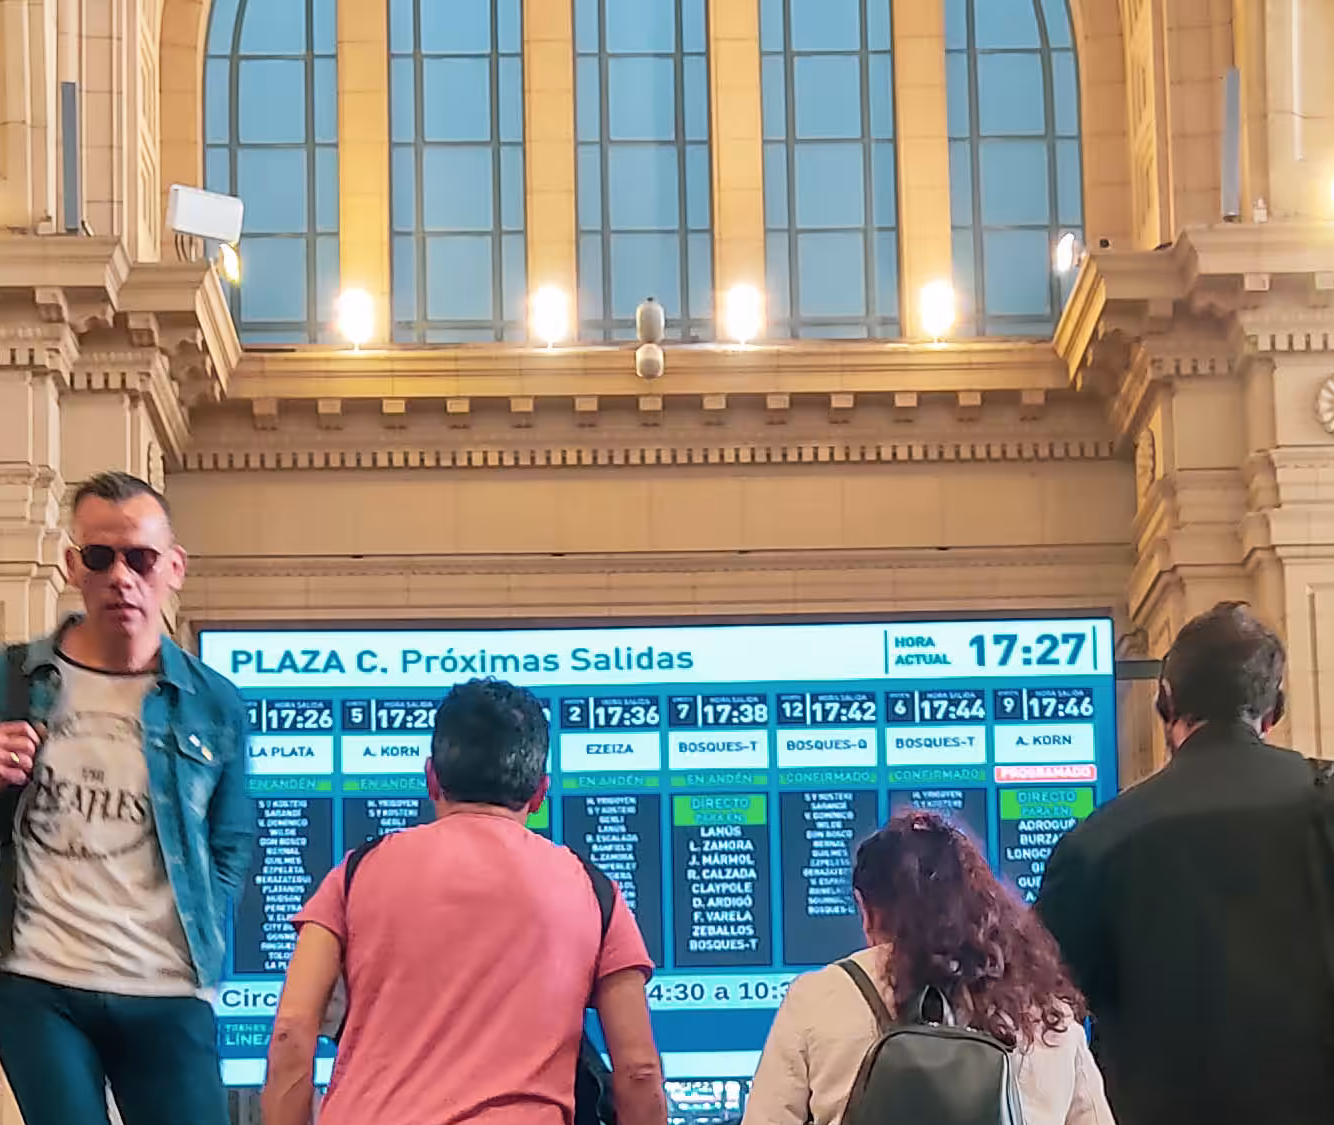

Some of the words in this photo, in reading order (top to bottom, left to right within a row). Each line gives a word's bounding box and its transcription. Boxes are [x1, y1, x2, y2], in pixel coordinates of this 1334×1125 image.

[894, 636, 935, 648] HORA
[969, 633, 1086, 666] 17:27
[231, 649, 346, 674] PLAZA
[356, 649, 388, 674] C.
[402, 647, 560, 673] Próximas
[570, 645, 694, 671] Salidas
[894, 653, 952, 665] ACTUAL
[782, 702, 804, 718] 12
[894, 699, 907, 715] 6
[920, 699, 986, 719] 17:44
[1003, 697, 1015, 713] 9
[1029, 697, 1094, 717] 17:46
[267, 708, 334, 729] 17:26
[351, 708, 364, 723] 5
[569, 706, 582, 722] 2
[595, 705, 660, 725] 17:36
[676, 704, 690, 720] 7
[703, 703, 768, 723] 17:38
[812, 702, 877, 722] 17:42
[678, 740, 758, 754] BOSQUES-T
[895, 736, 975, 749] BOSQUES-T
[1033, 735, 1072, 746] KORN
[248, 746, 267, 758] LA
[271, 745, 315, 757] PLATA
[381, 746, 420, 757] KORN
[586, 743, 634, 755] EZEIZA
[579, 776, 596, 787] EN
[688, 774, 704, 785] EN
[894, 769, 980, 781] CONFIRMADO
[1017, 791, 1077, 802] DIRECTO
[691, 797, 749, 810] DIRECTO
[700, 825, 742, 837] LANÚS
[702, 839, 754, 851] ZAMORA
[1020, 833, 1063, 845] BURZA
[702, 852, 755, 865] MÁRMOL
[702, 868, 757, 880] CALZADA
[692, 882, 753, 893] CLAYPOLE
[706, 911, 753, 922] VARELA
[692, 925, 755, 936] ZEBALLOS
[689, 939, 758, 950] BOSQUES-T
[221, 988, 278, 1007] Circ
[714, 986, 731, 1000] a
